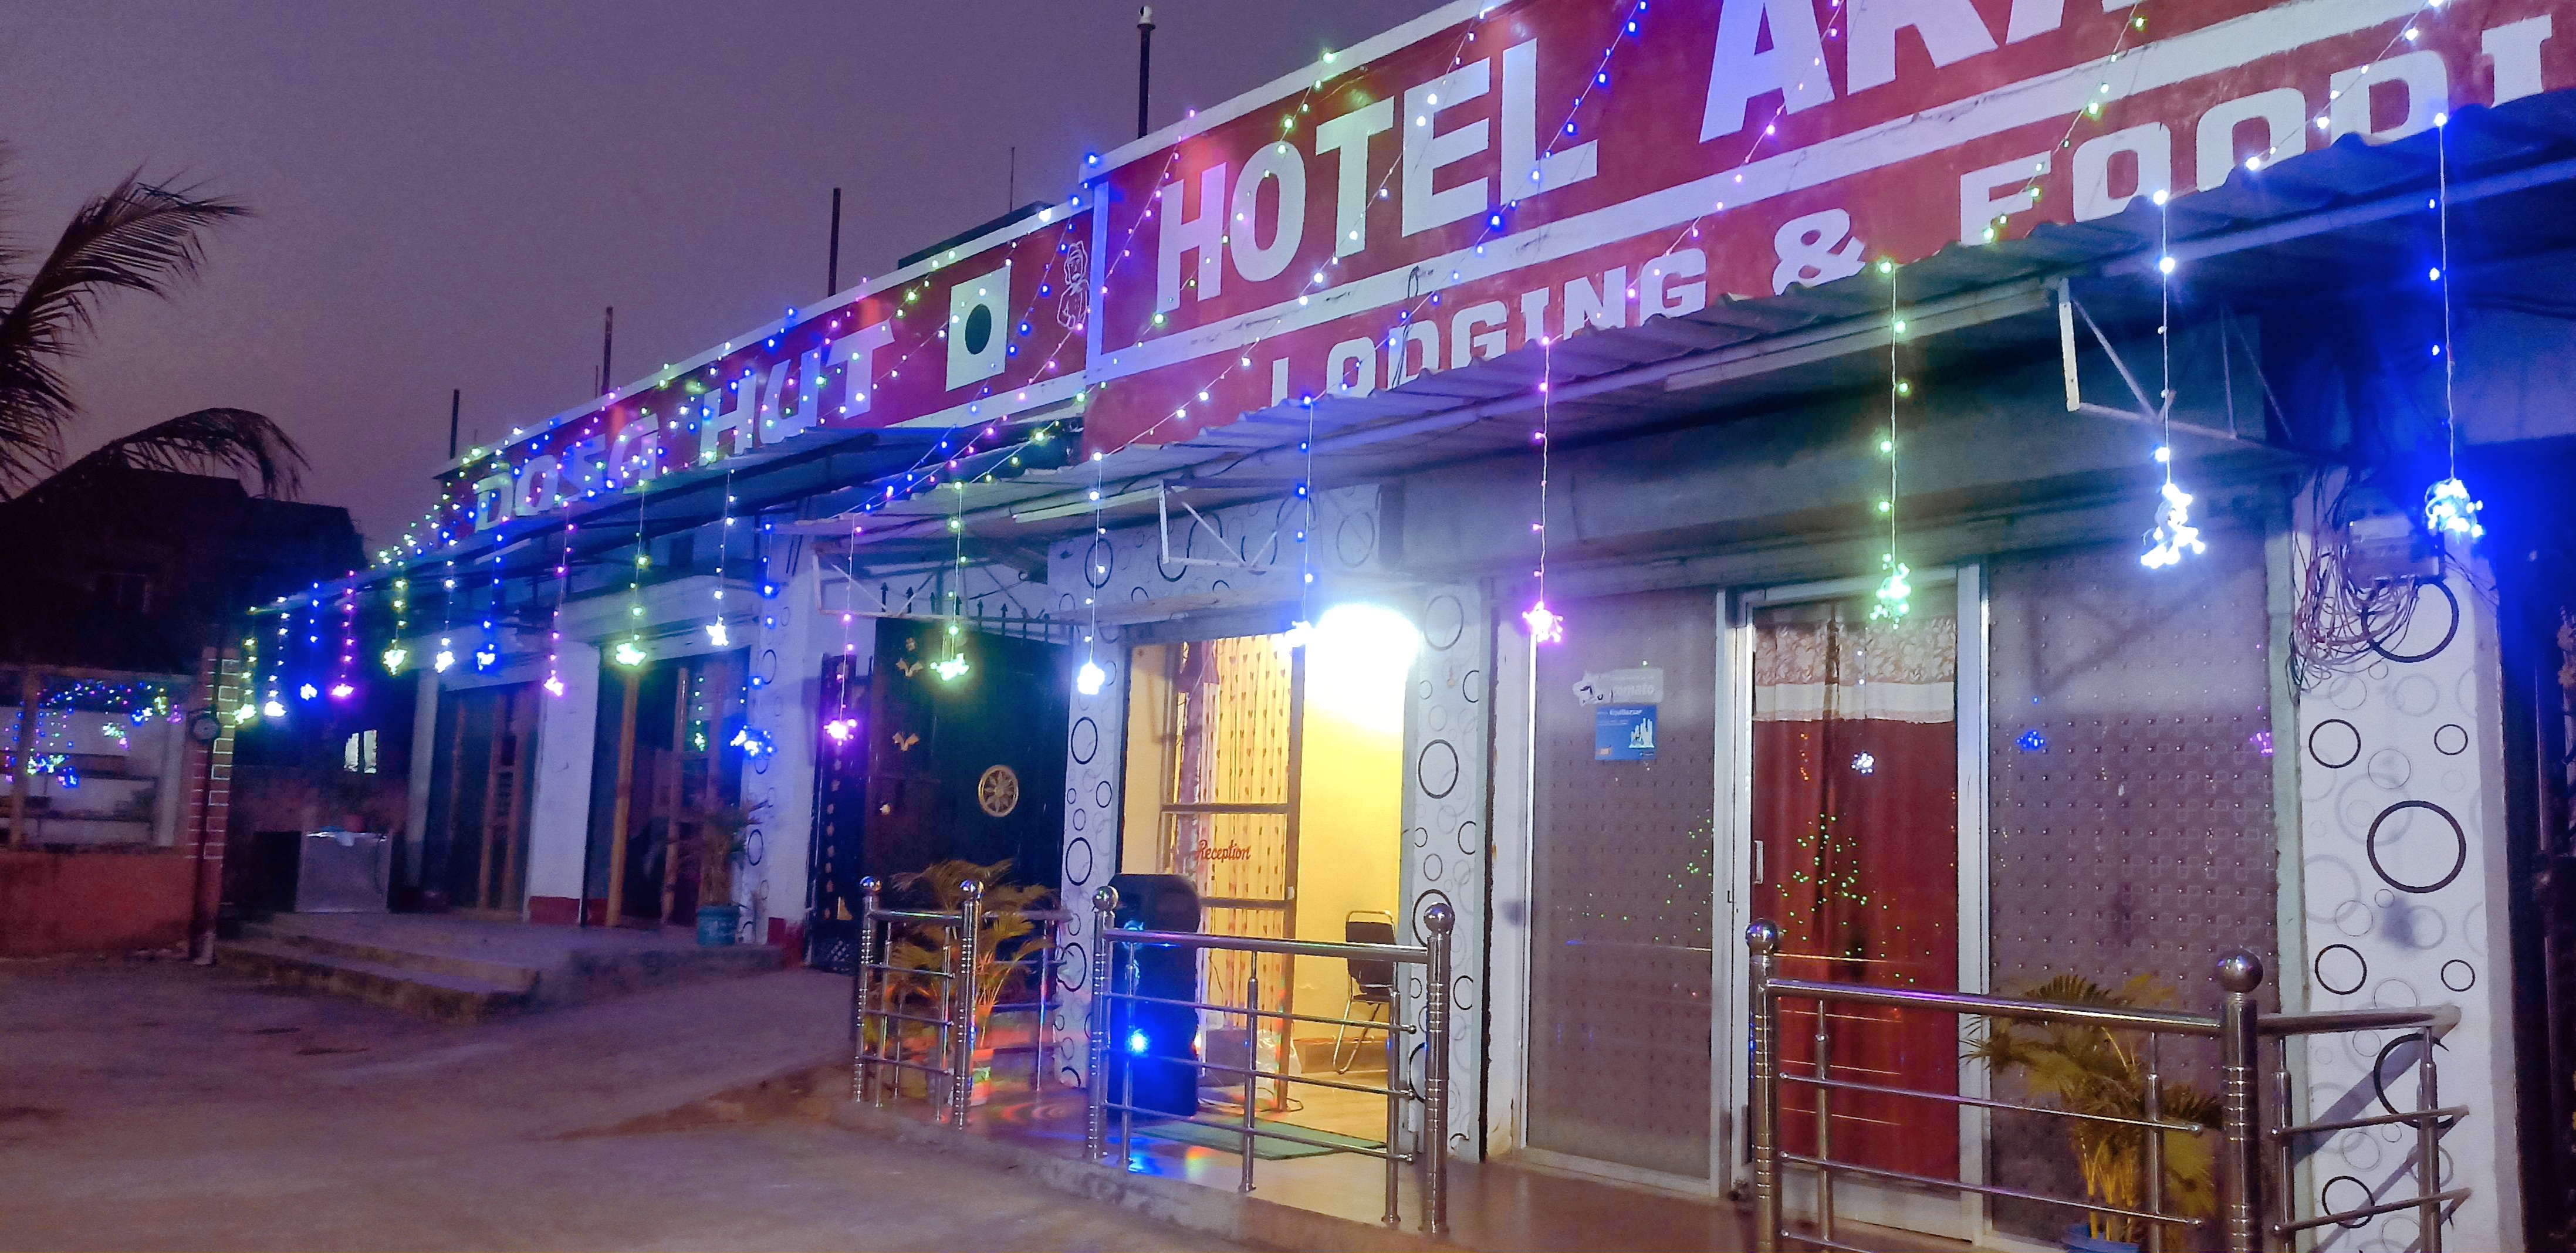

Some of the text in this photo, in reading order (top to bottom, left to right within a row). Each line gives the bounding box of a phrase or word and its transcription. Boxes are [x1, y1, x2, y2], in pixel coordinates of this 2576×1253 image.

[1155, 38, 1598, 313] HOTEL
[1772, 208, 1866, 296] &
[698, 319, 895, 466] HUT
[1196, 839, 1251, 863] Reception
